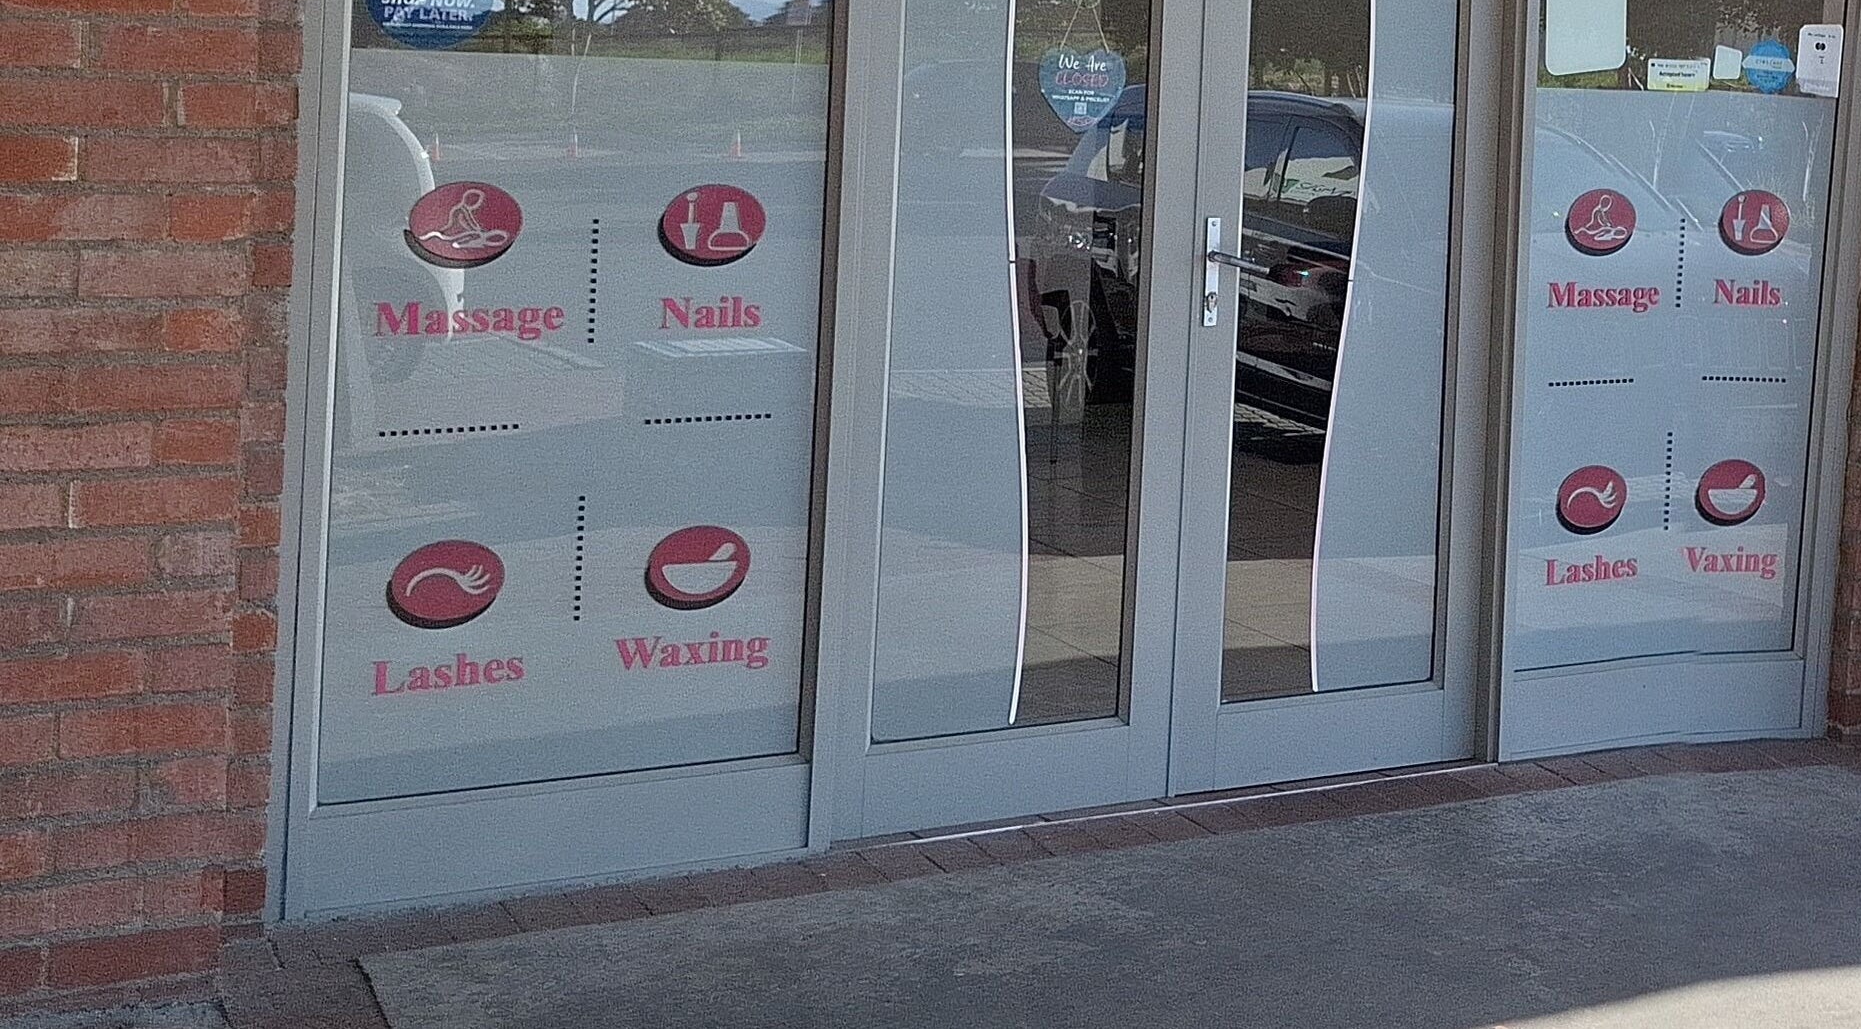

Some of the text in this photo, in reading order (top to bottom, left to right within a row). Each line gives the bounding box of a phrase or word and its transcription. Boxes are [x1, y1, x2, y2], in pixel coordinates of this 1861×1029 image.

[383, 5, 415, 19] PAY
[1055, 70, 1109, 88] CLOSED
[1058, 53, 1107, 72] We Are
[1547, 280, 1661, 313] Massage
[1714, 278, 1782, 306] Nails
[373, 299, 566, 342] Massage
[659, 295, 763, 331] Nails
[1544, 554, 1639, 587] Lashes
[614, 631, 771, 671] Waxing
[371, 652, 525, 697] Lashes
